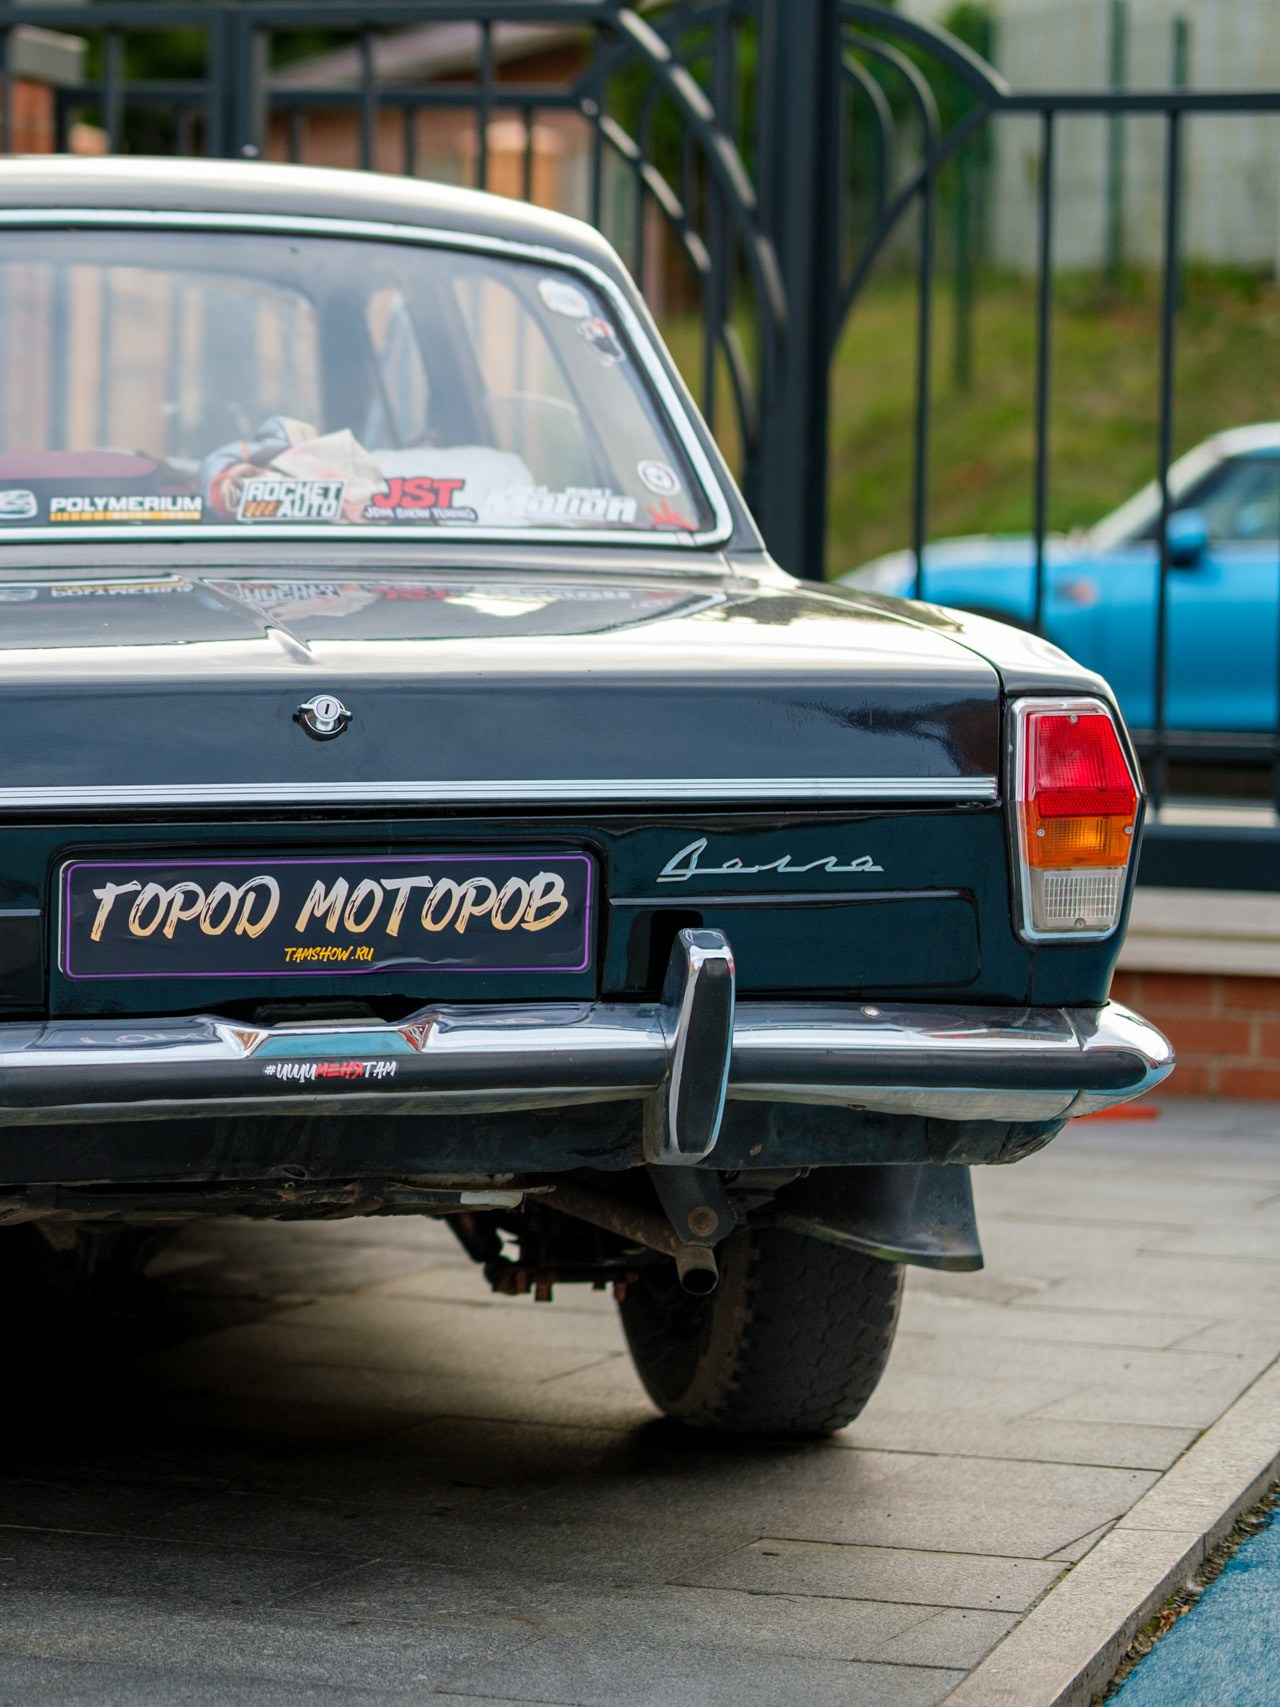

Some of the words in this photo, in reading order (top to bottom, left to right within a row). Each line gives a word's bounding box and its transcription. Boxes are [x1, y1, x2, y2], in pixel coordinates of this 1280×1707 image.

[246, 481, 342, 501] ROCKET
[372, 477, 465, 509] JST
[50, 496, 202, 511] POLYMERIUM
[277, 500, 338, 518] AUTO
[90, 875, 280, 941] ГОРОД
[294, 871, 569, 937] МОТОРОВ
[284, 945, 374, 963] TAMSHOW.RU
